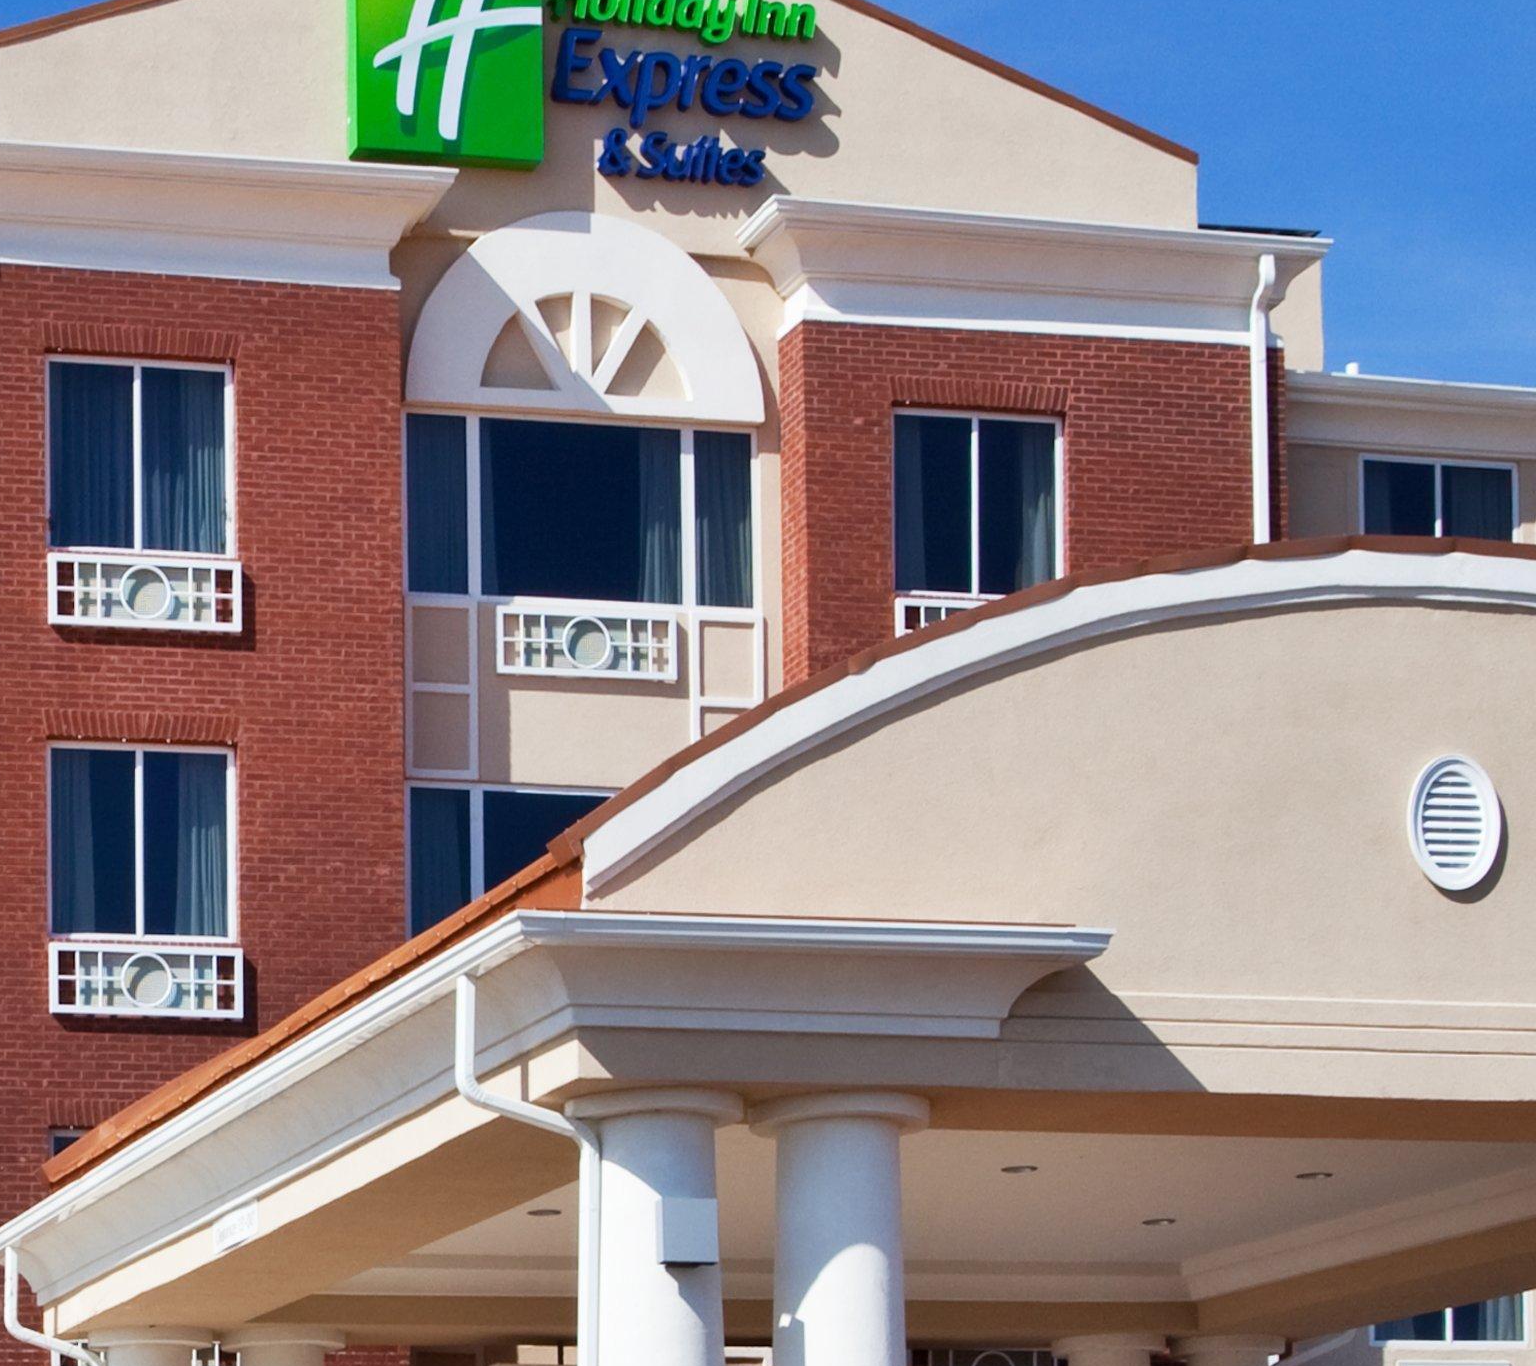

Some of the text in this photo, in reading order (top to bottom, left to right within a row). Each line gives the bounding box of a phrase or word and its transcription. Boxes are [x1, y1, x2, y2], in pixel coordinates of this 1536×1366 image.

[551, 27, 817, 129] Express
[596, 128, 767, 186] & Suites
